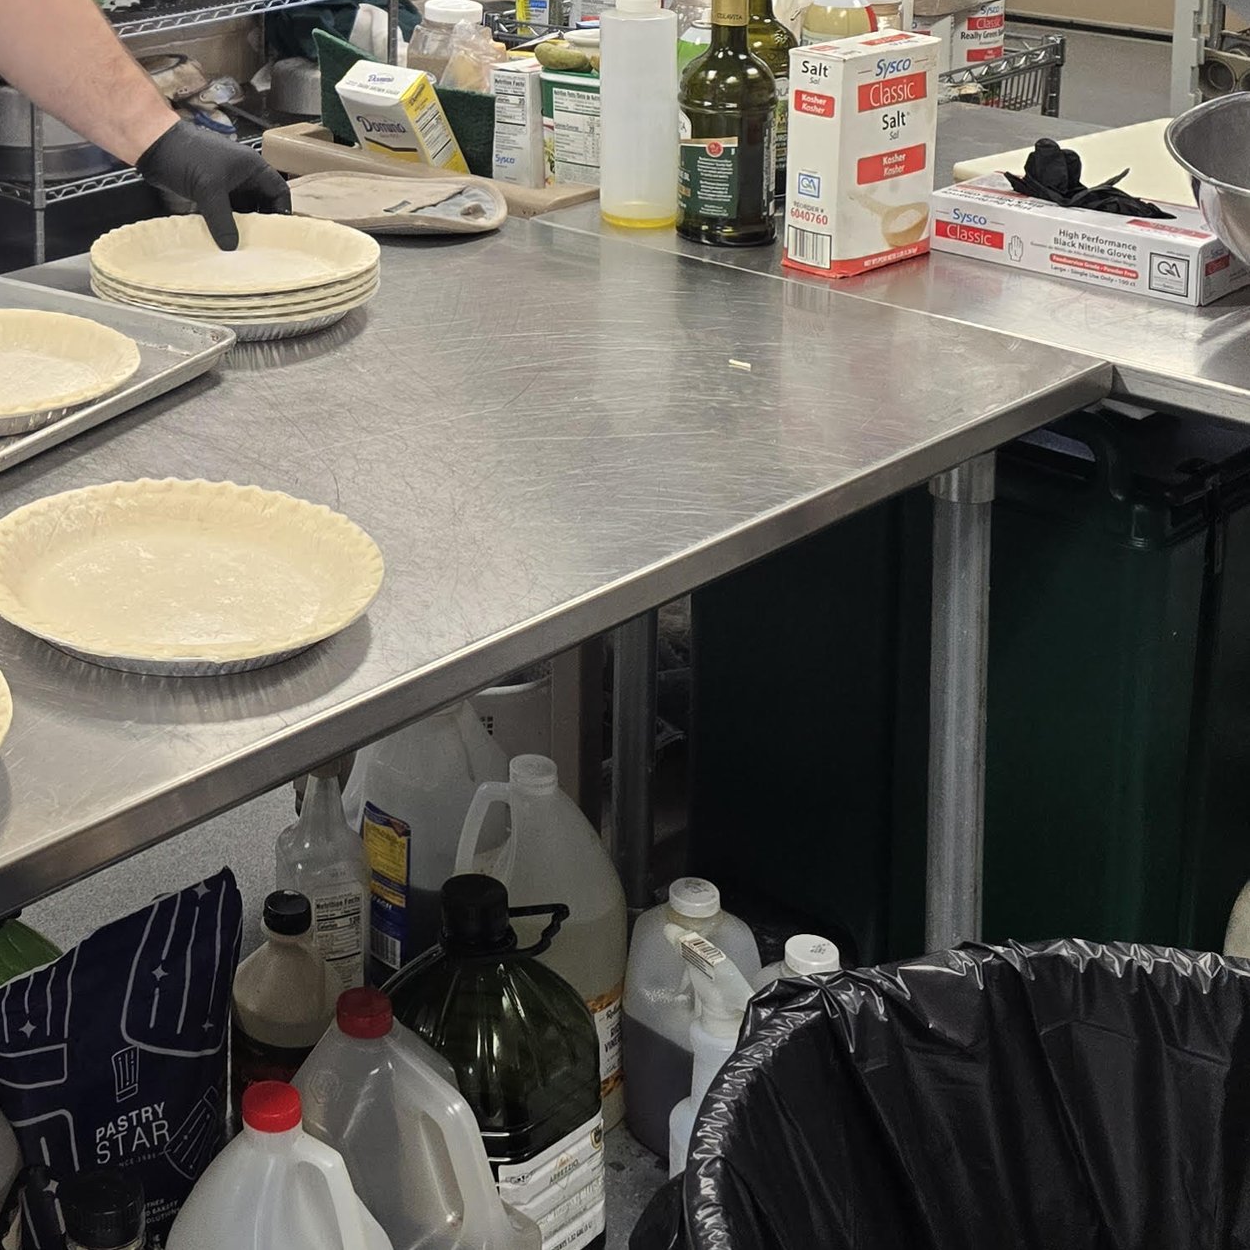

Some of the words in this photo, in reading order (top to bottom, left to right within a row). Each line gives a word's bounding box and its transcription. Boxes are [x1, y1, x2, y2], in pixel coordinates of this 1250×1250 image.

[980, 5, 1000, 17] Sysco
[961, 31, 982, 40] Really
[801, 60, 829, 78] Salt
[875, 58, 912, 78] Sysco
[801, 93, 827, 106] Kosher
[869, 80, 916, 107] Classic
[801, 103, 826, 115] Kosher
[356, 115, 406, 134] Domino
[882, 110, 906, 131] Salt
[495, 154, 516, 165] Sysco
[883, 152, 906, 166] Kosher
[883, 163, 906, 177] Kosher
[793, 200, 820, 213] REORDER
[790, 207, 828, 225] 6040760
[953, 208, 987, 225] Sysco
[946, 224, 992, 246] Classic
[1059, 228, 1079, 240] High
[1081, 233, 1137, 251] Performance
[1053, 237, 1077, 249] Black
[1078, 242, 1106, 255] Nitrile
[1106, 248, 1137, 261] Gloves
[1051, 264, 1066, 273] Large
[1071, 268, 1088, 278] Single
[1089, 271, 1099, 279] Use
[1101, 274, 1114, 283] Only
[1052, 255, 1084, 266] Foodservice
[1124, 270, 1137, 278] Free
[95, 1101, 166, 1144] PASTRY
[96, 1119, 170, 1165] STAR
